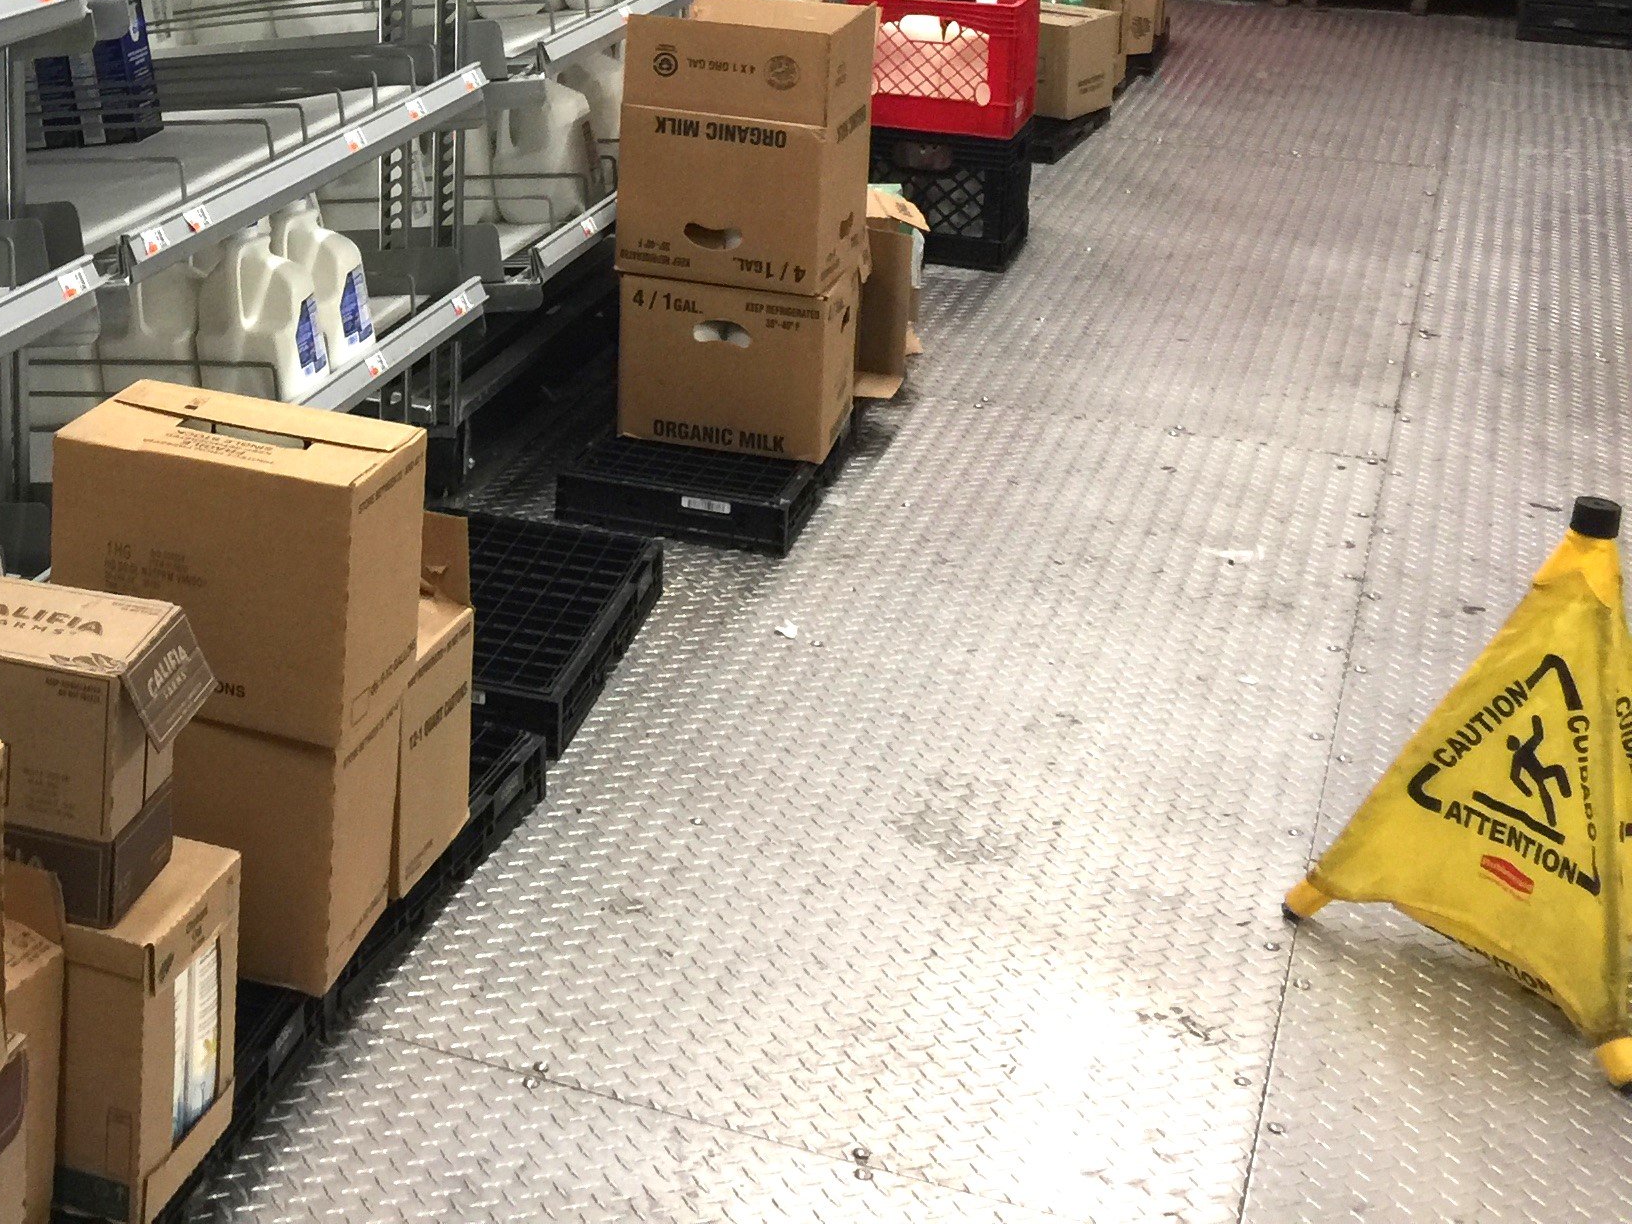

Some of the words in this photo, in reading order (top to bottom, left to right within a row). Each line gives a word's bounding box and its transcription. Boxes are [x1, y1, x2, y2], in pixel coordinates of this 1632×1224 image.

[655, 115, 700, 138] MILK
[706, 121, 787, 149] ORGANIC
[632, 289, 645, 307] 4
[653, 419, 733, 446] ORGANIC
[739, 431, 785, 453] MILK
[147, 643, 189, 699] CALIFIA
[214, 681, 246, 698] ONS
[1433, 680, 1529, 768] CAUTION
[1567, 714, 1597, 842] CUIDADO
[1443, 800, 1578, 885] ATTENTION
